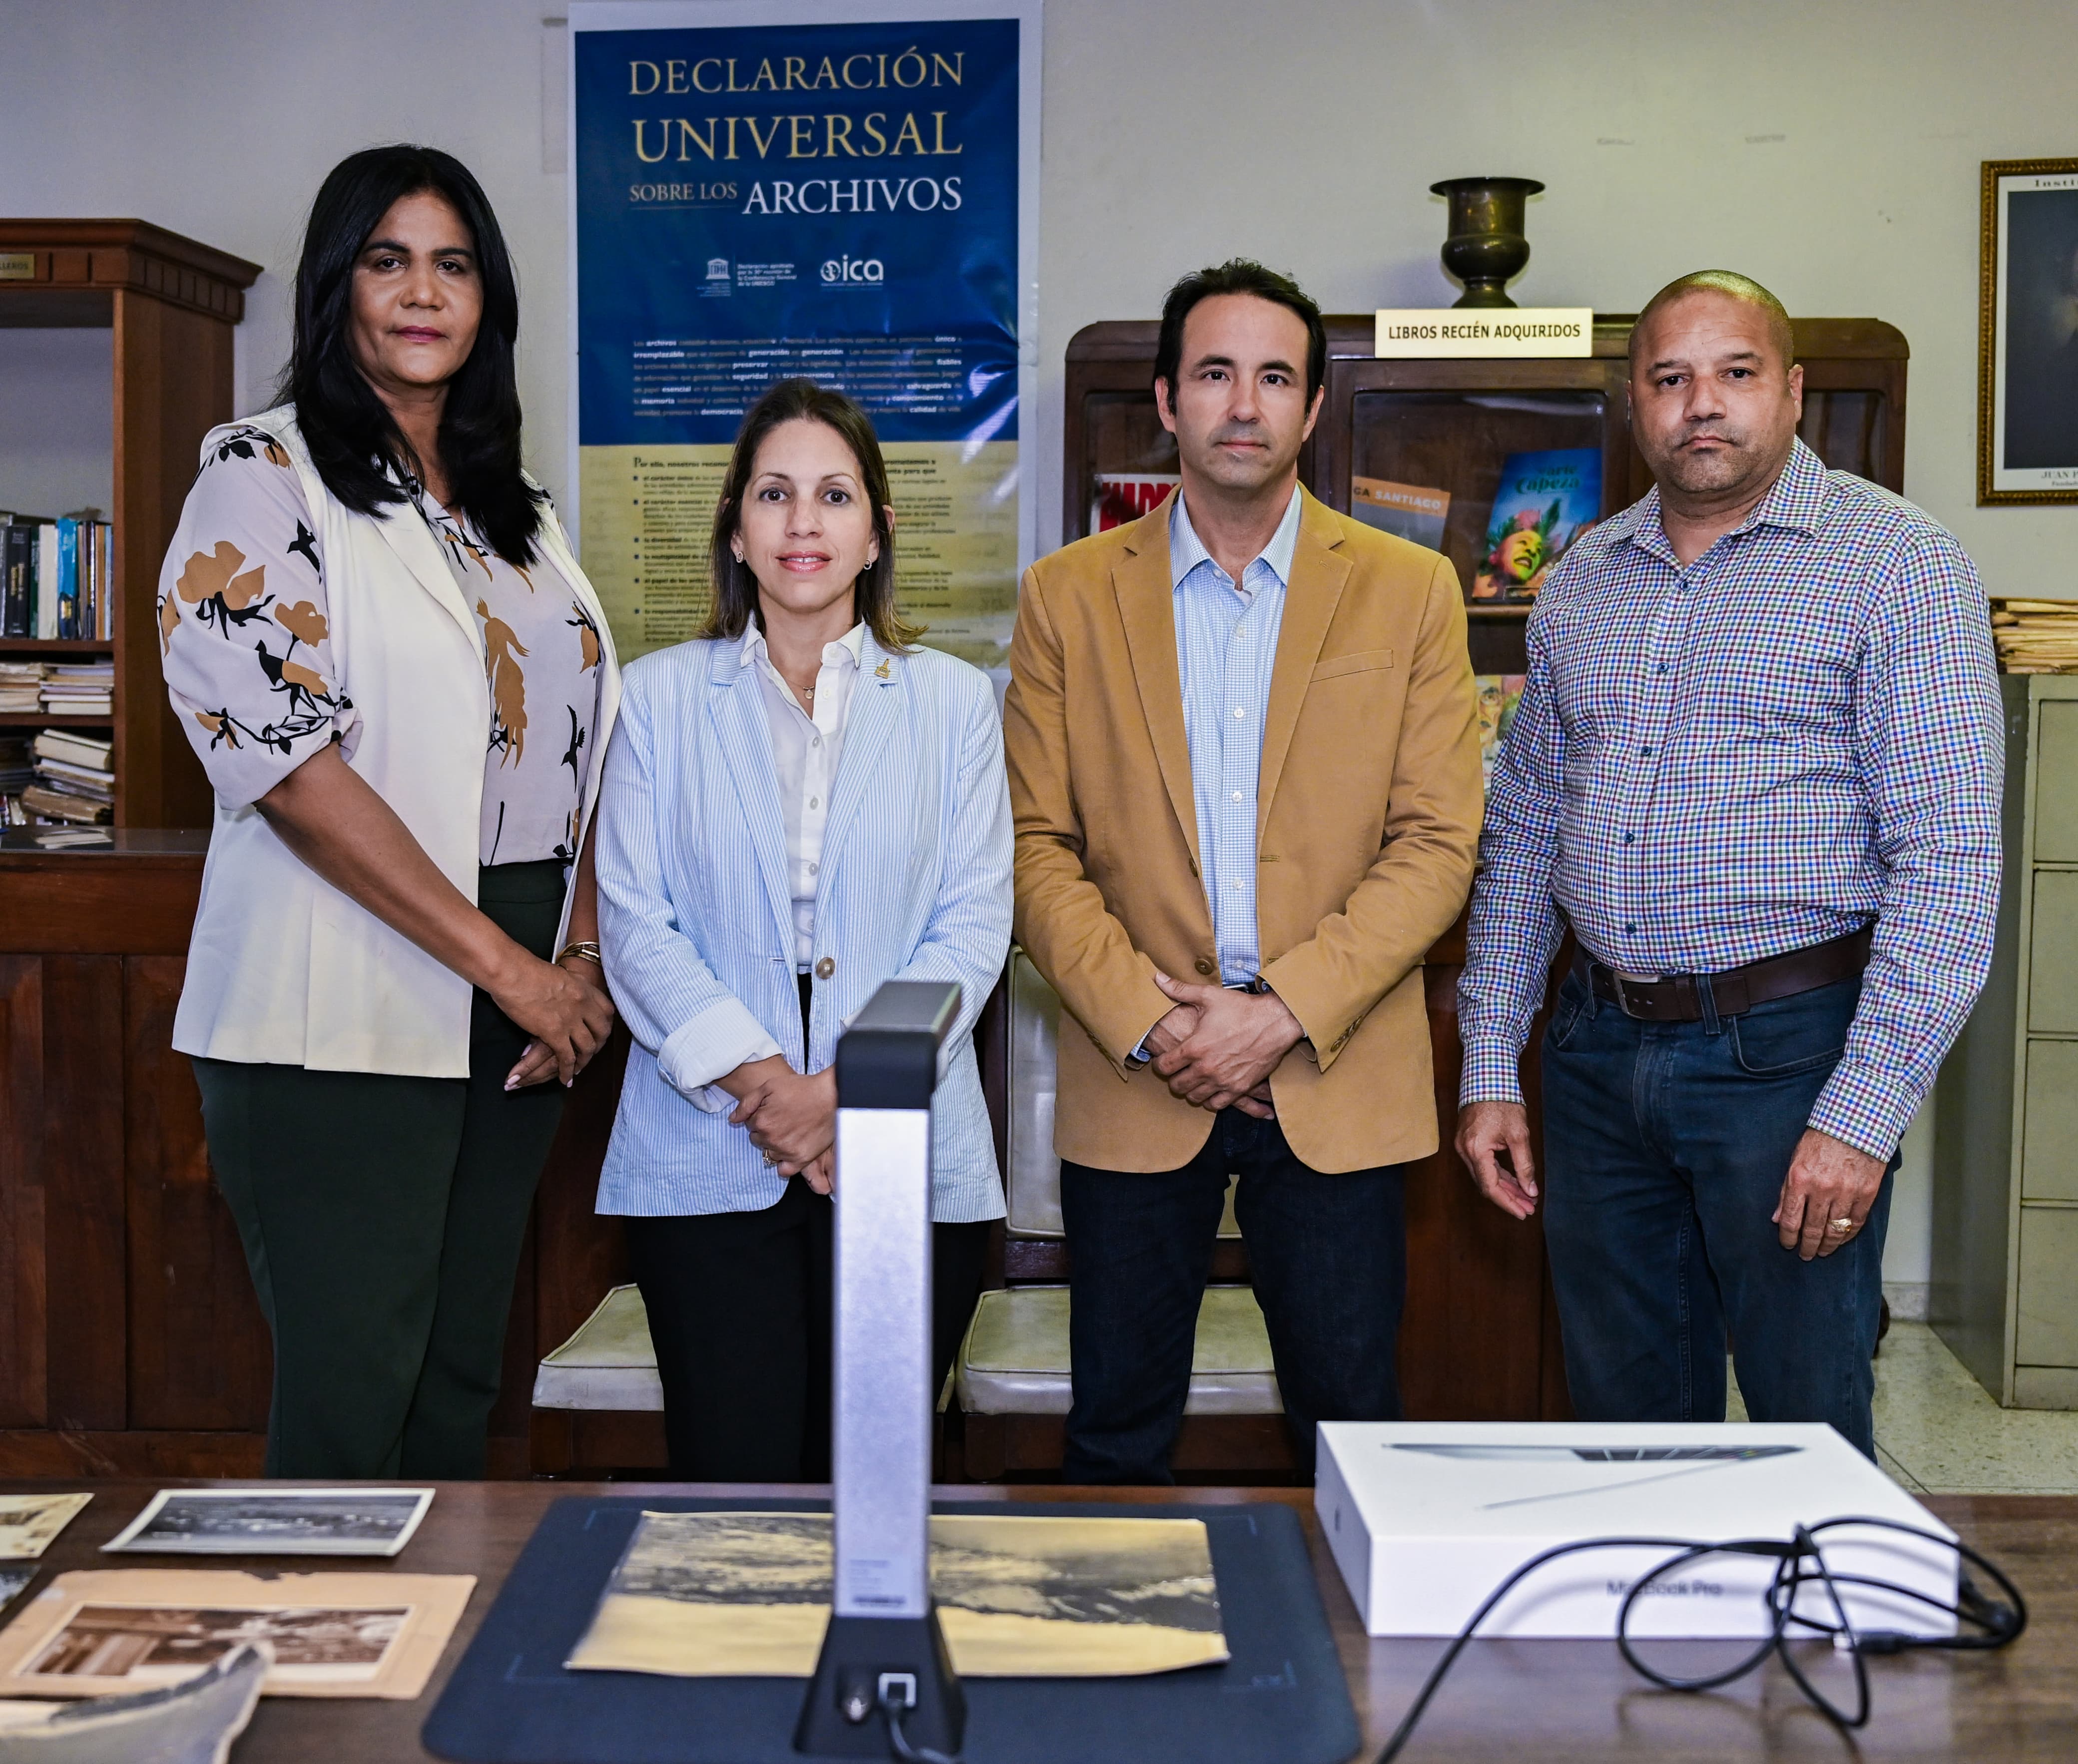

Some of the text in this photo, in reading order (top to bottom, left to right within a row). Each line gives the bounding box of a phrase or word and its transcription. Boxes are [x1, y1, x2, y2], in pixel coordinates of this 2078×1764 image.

[628, 45, 965, 95] DECLARACIÓN
[631, 111, 963, 162] UNIVERSAL
[2035, 178, 2078, 187] Insti
[630, 176, 962, 214] SOBRE LOS ARCHIVOS
[843, 254, 884, 281] ica
[1389, 321, 1580, 341] LIBROS RECIÉN ADQUIRIDOS
[1375, 490, 1442, 510] SANTIAGO
[1692, 1580, 1724, 1596] Pro
